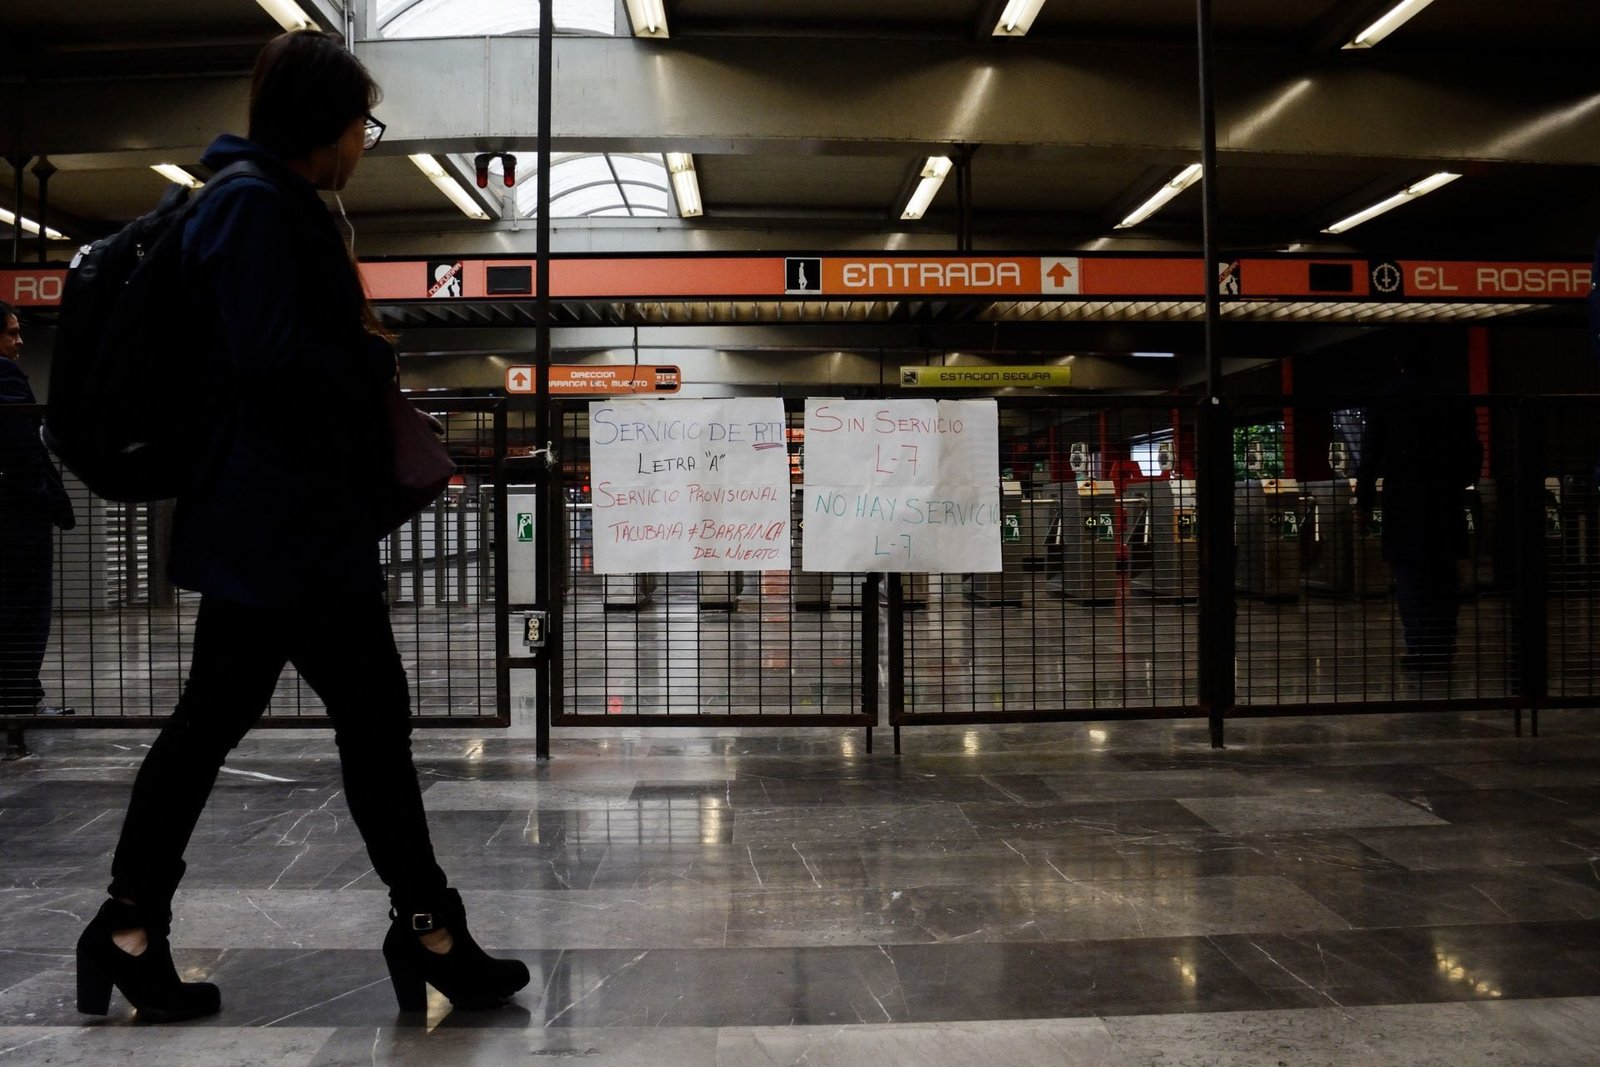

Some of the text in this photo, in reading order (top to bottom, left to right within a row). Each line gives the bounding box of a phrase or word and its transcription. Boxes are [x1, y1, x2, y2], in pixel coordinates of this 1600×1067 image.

[843, 262, 1020, 287] ENTRADA
[1414, 266, 1458, 291] EL
[14, 276, 63, 300] RO
[428, 284, 440, 296] NO
[570, 371, 616, 379] DIRECCION
[940, 372, 1051, 381] ESTACION SEGURA
[594, 408, 702, 445] SERVICIO
[708, 423, 746, 443] DE
[809, 406, 964, 434] SIN SERVICIO
[638, 452, 696, 475] LETRA
[596, 481, 778, 509] SERVICIO PROVISIONAL
[815, 491, 847, 518] NO
[856, 493, 897, 522] HAY
[608, 519, 685, 544] TACUBAYA
[699, 518, 786, 543] BARRANCA
[692, 545, 720, 561] DEL
